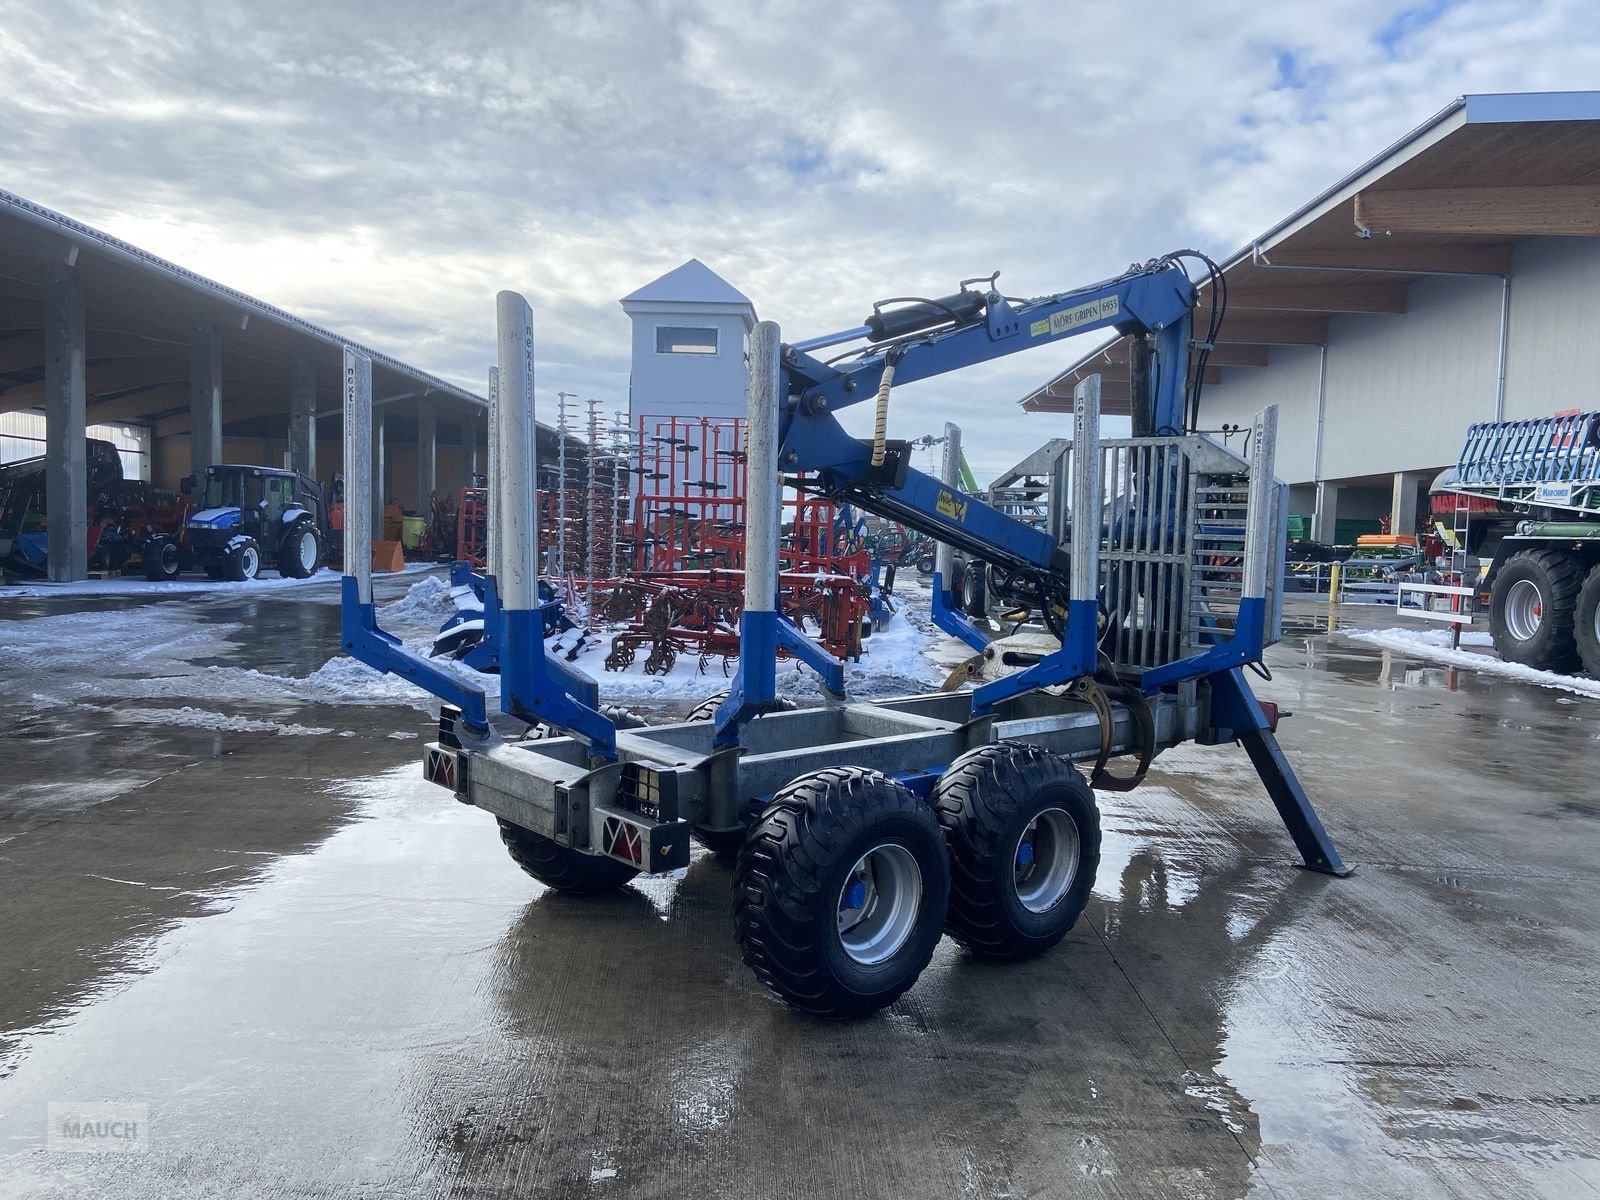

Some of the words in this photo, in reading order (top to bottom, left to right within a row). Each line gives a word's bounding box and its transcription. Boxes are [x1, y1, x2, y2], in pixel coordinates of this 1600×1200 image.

[1102, 299, 1118, 312] 6955
[1053, 313, 1074, 329] MÖRE
[1074, 306, 1098, 322] GRIPEN
